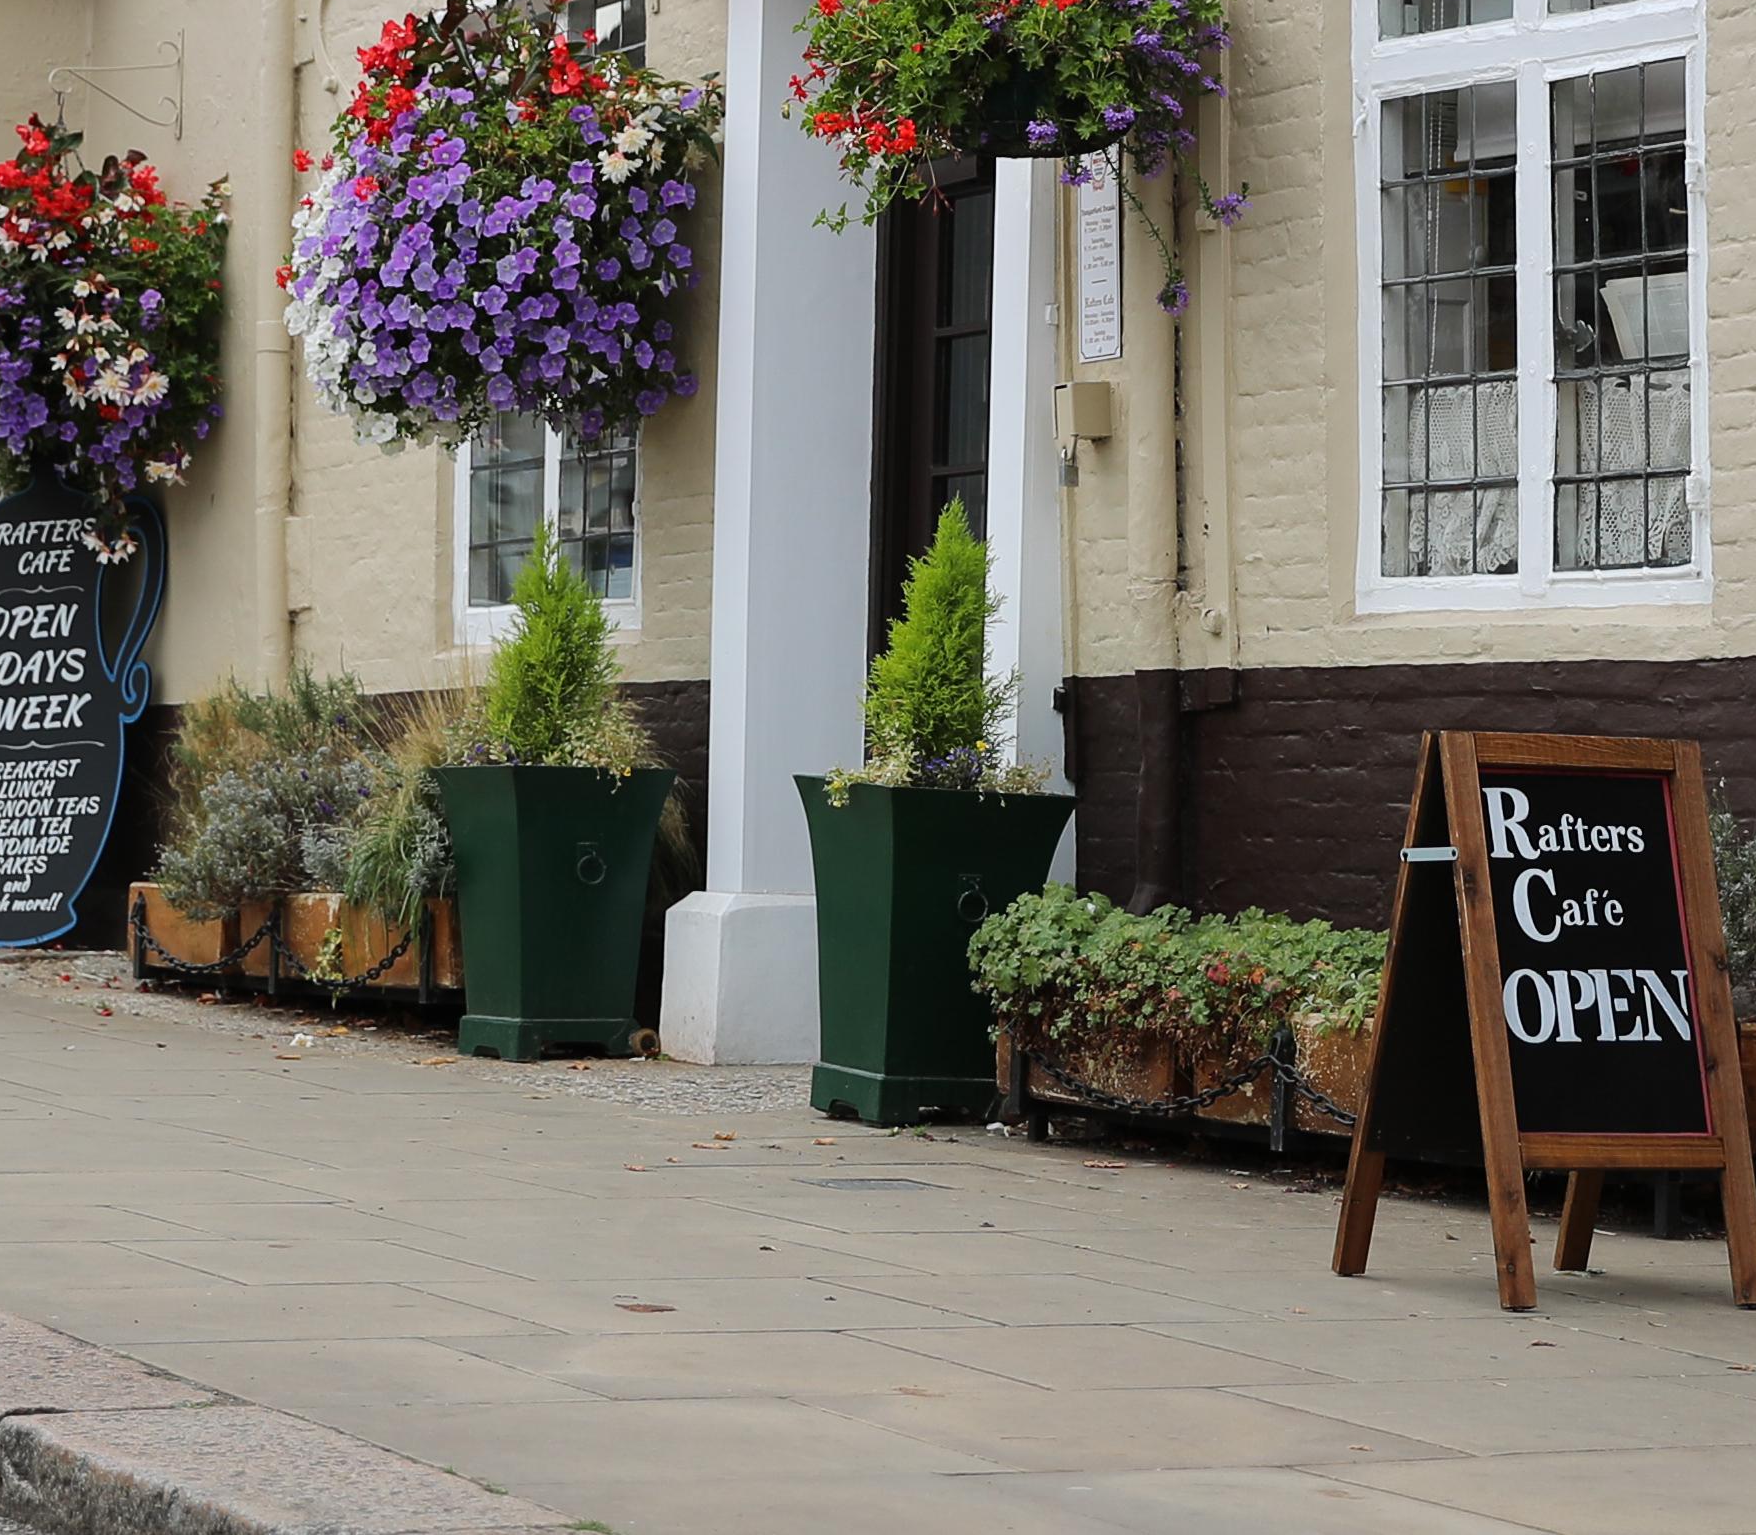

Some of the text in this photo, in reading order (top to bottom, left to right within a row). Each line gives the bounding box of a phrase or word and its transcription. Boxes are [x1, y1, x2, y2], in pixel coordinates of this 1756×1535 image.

[18, 544, 74, 575] CAFÉ
[56, 796, 101, 815] TEAS
[39, 817, 72, 835] TEA
[1482, 787, 1645, 860] Rafters
[2, 873, 31, 893] and
[12, 892, 63, 912] more!!
[1512, 868, 1625, 943] Café
[1502, 967, 1692, 1045] OPEN
